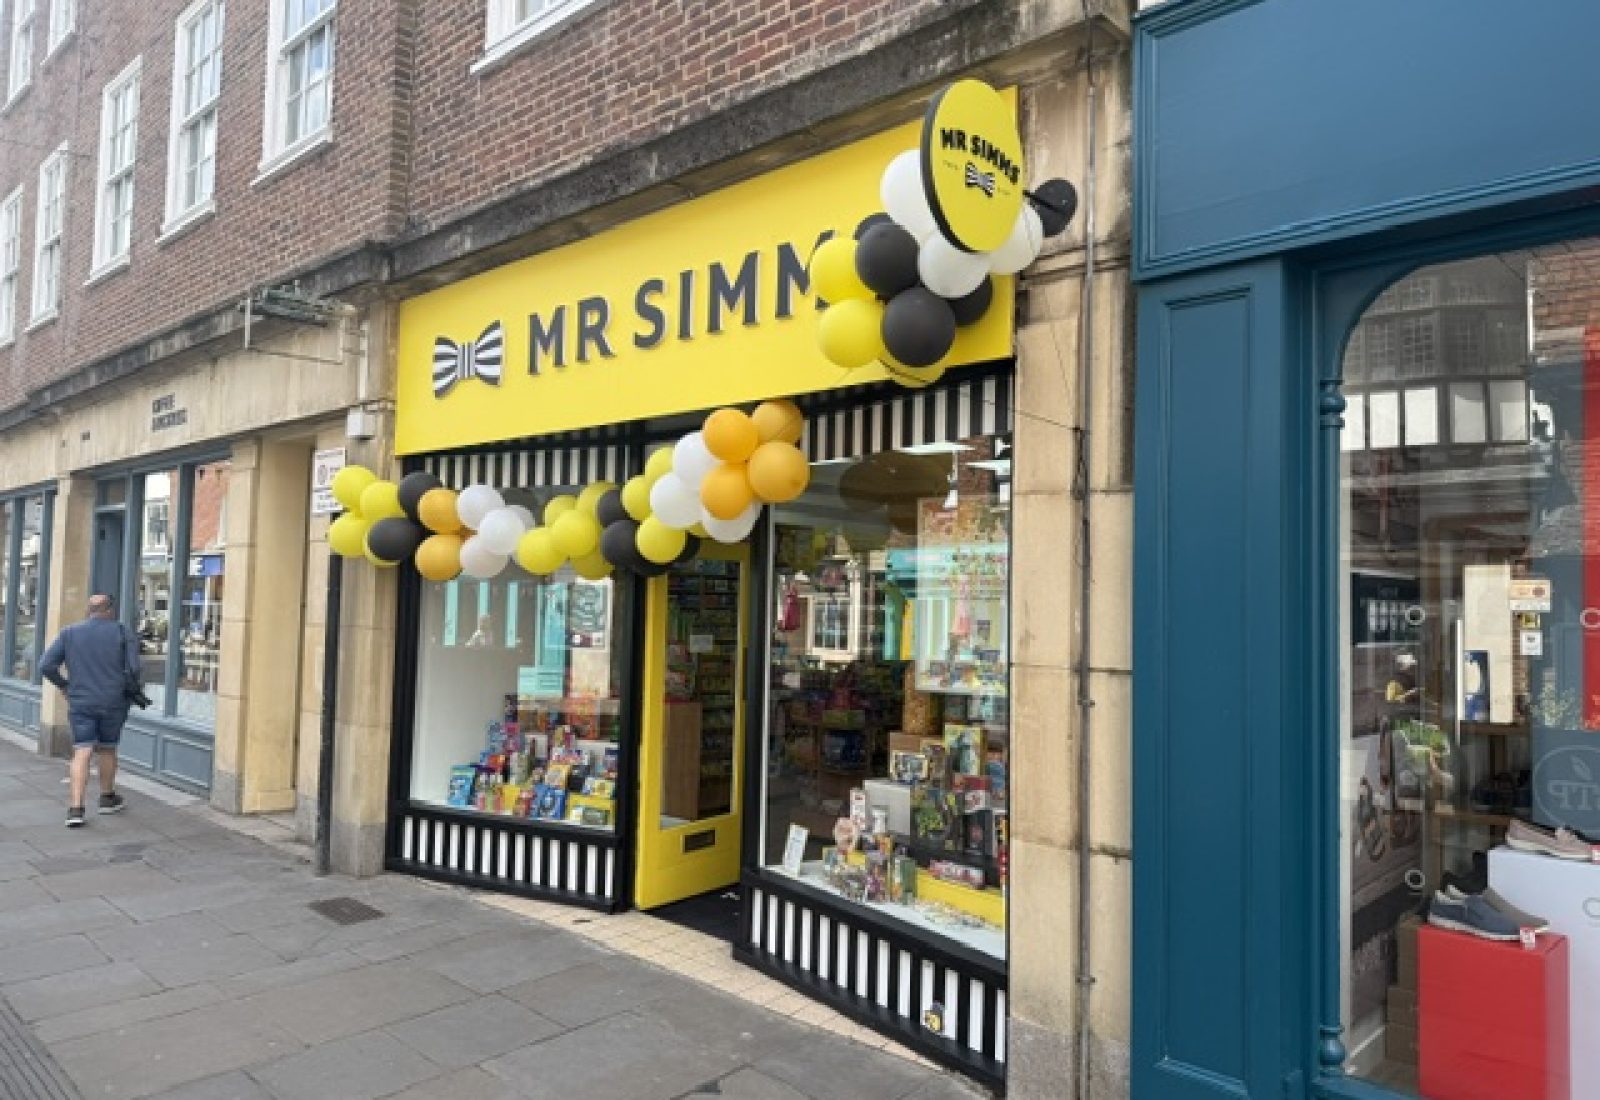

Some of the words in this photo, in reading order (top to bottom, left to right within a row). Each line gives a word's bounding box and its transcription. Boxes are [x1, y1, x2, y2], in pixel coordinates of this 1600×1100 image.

[940, 128, 967, 152] MR
[970, 134, 1020, 185] SIMMS
[527, 296, 616, 375] MR
[632, 229, 837, 350] SIMM
